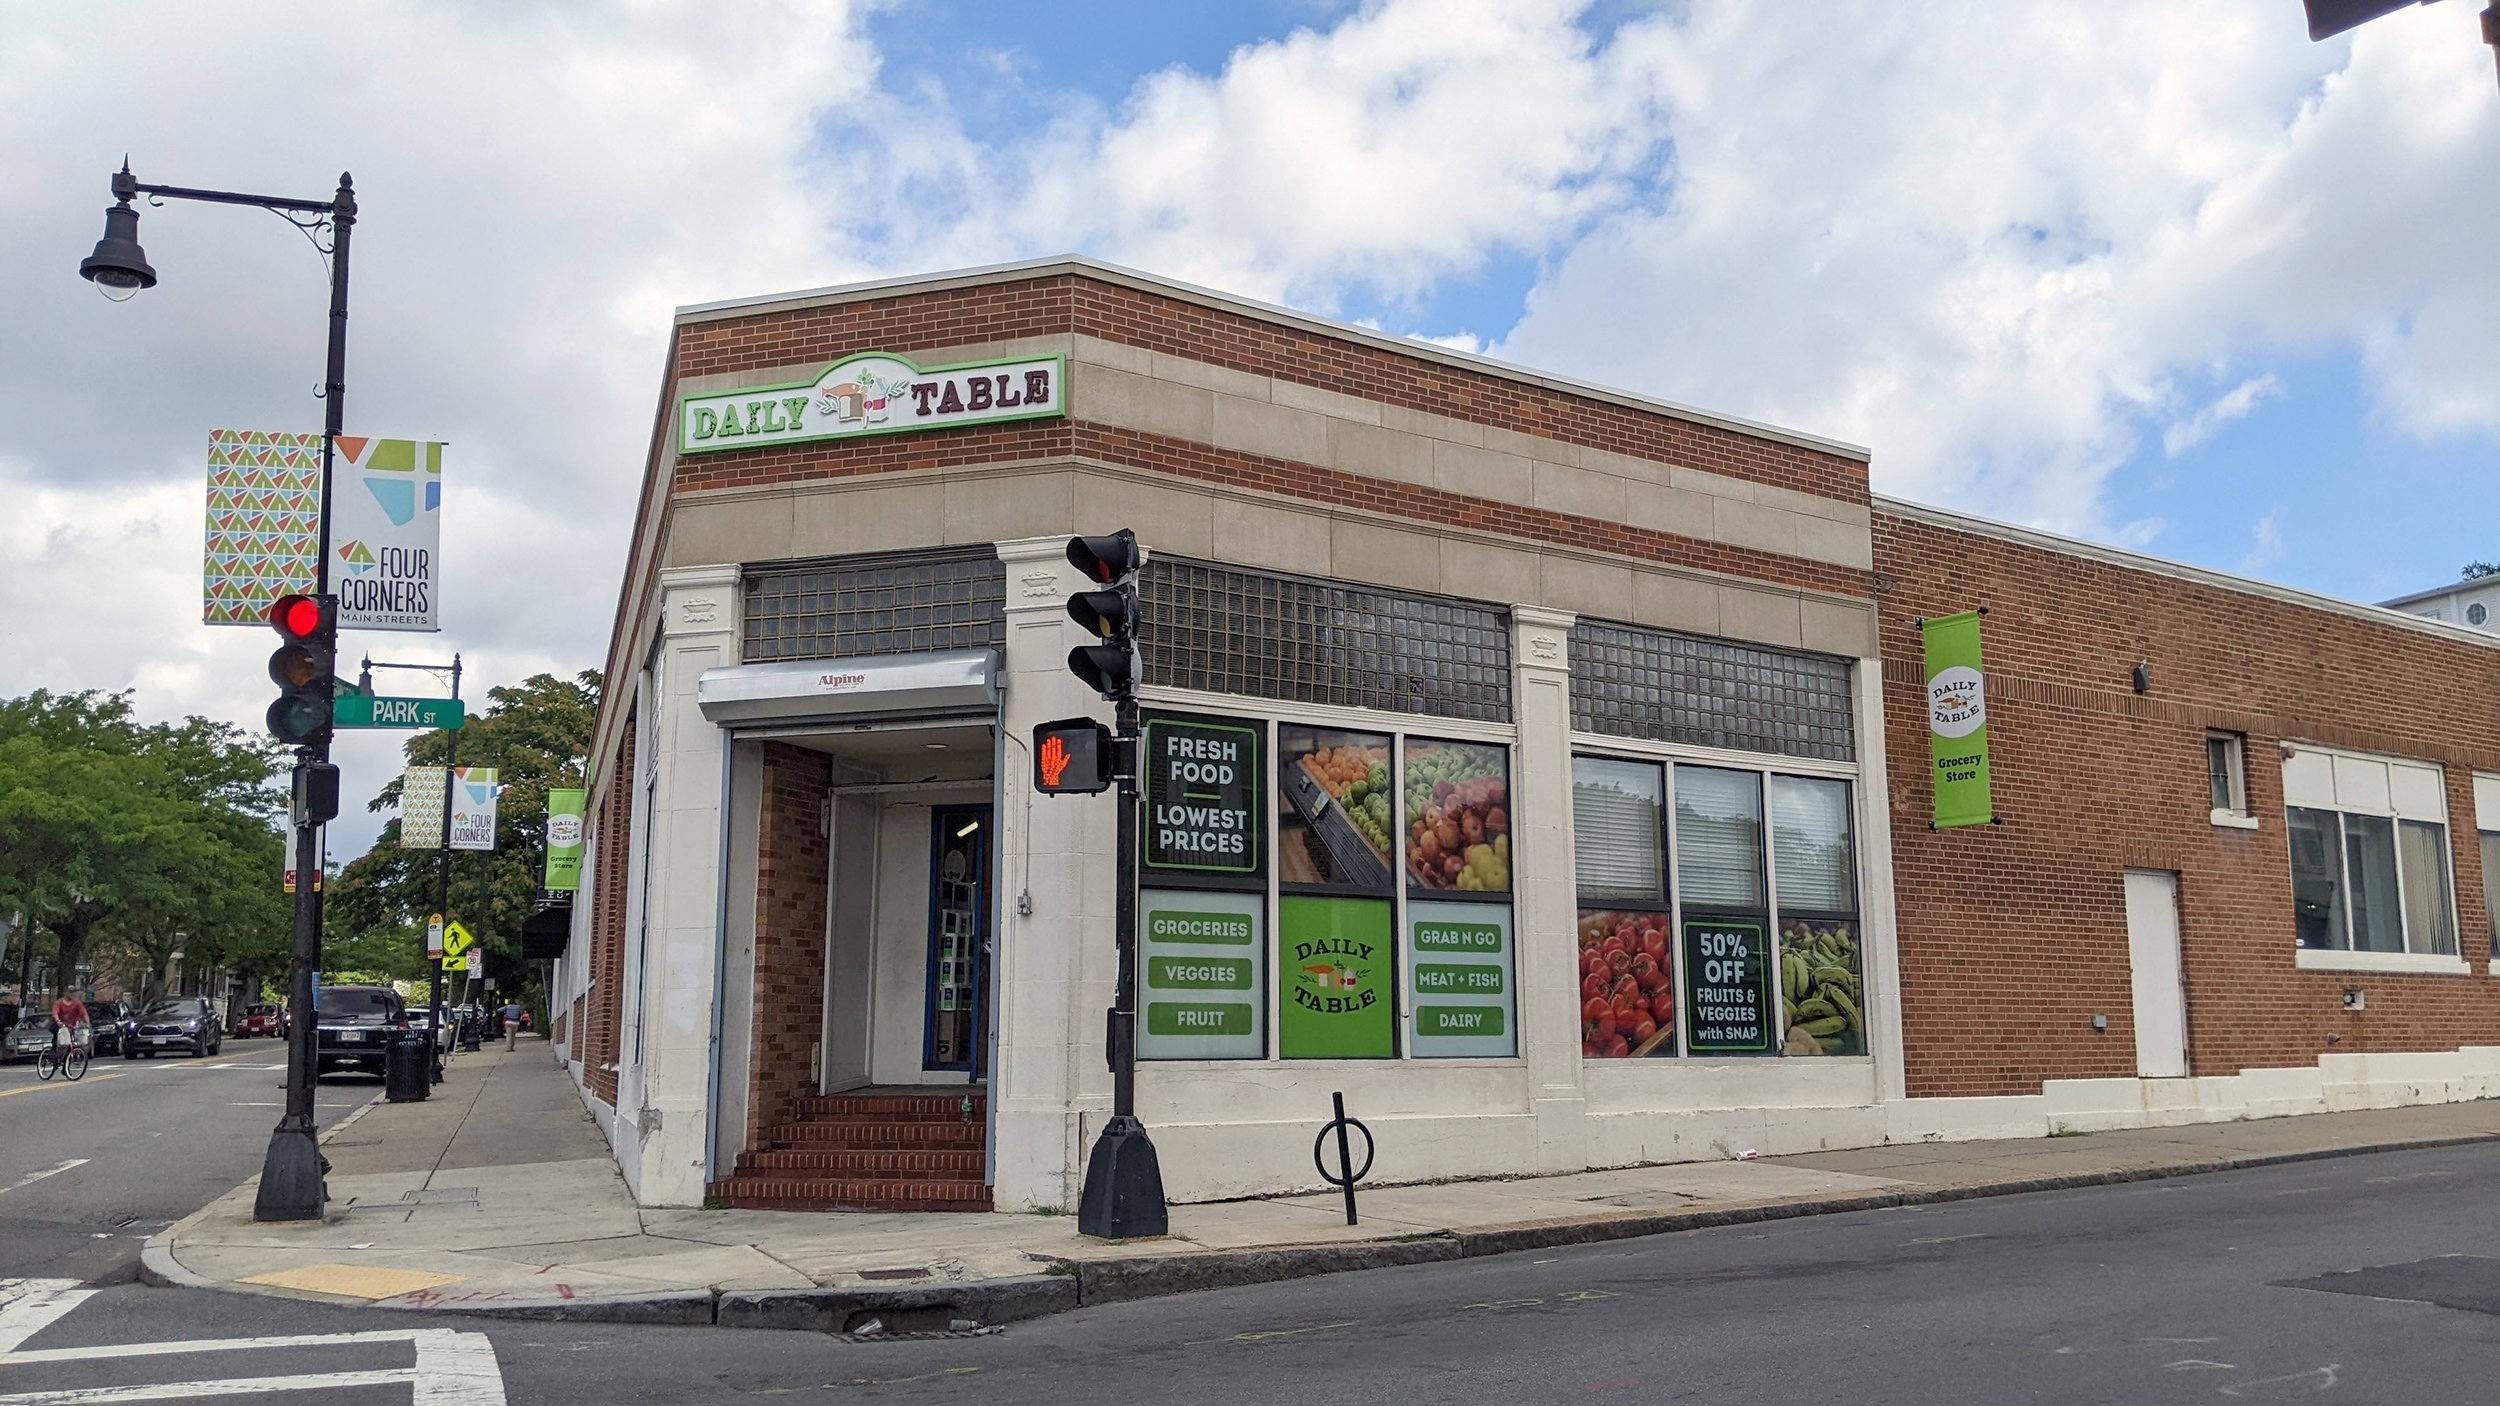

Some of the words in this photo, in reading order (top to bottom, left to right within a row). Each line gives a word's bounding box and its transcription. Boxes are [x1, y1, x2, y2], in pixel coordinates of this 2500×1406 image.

[692, 396, 810, 440] DAILY
[911, 369, 1050, 416] TABLE
[380, 547, 429, 580] FOUR
[341, 578, 429, 613] CORNERS
[341, 613, 371, 622] MAIN
[376, 615, 428, 625] STREETS
[818, 674, 865, 687] Alpine
[1933, 681, 1977, 699] DAILY
[372, 700, 420, 723] PARK
[423, 712, 437, 724] ST
[1934, 704, 1980, 723] TABLE
[1167, 736, 1237, 762] FRESH
[1938, 754, 1982, 769] Grocery
[1171, 761, 1234, 785] FOOD
[1946, 770, 1976, 782] Store
[470, 814, 491, 828] FOUR
[1157, 804, 1247, 829] LOWEST
[454, 828, 491, 842] CORNERS
[1160, 829, 1244, 854] PRICES
[1154, 919, 1248, 937] GROCERIES
[1421, 929, 1459, 944] GRAB
[1462, 931, 1472, 945] N
[1475, 931, 1496, 946] GO
[1700, 932, 1747, 958] 50%
[1294, 938, 1374, 961] DAILY
[1165, 965, 1236, 982] VEGGIES
[1419, 972, 1455, 986] MEAT
[1468, 973, 1499, 987] FISH
[1704, 959, 1745, 984] OFF
[1294, 984, 1377, 1013] TABLE
[1697, 988, 1744, 1003] FRUITS
[1746, 989, 1755, 1004] &
[1177, 1010, 1225, 1026] FRUIT
[1439, 1013, 1482, 1028] DAIRY
[1697, 1006, 1757, 1022] VEGGIES
[1698, 1026, 1723, 1040] with
[1725, 1027, 1758, 1040] SNAP
